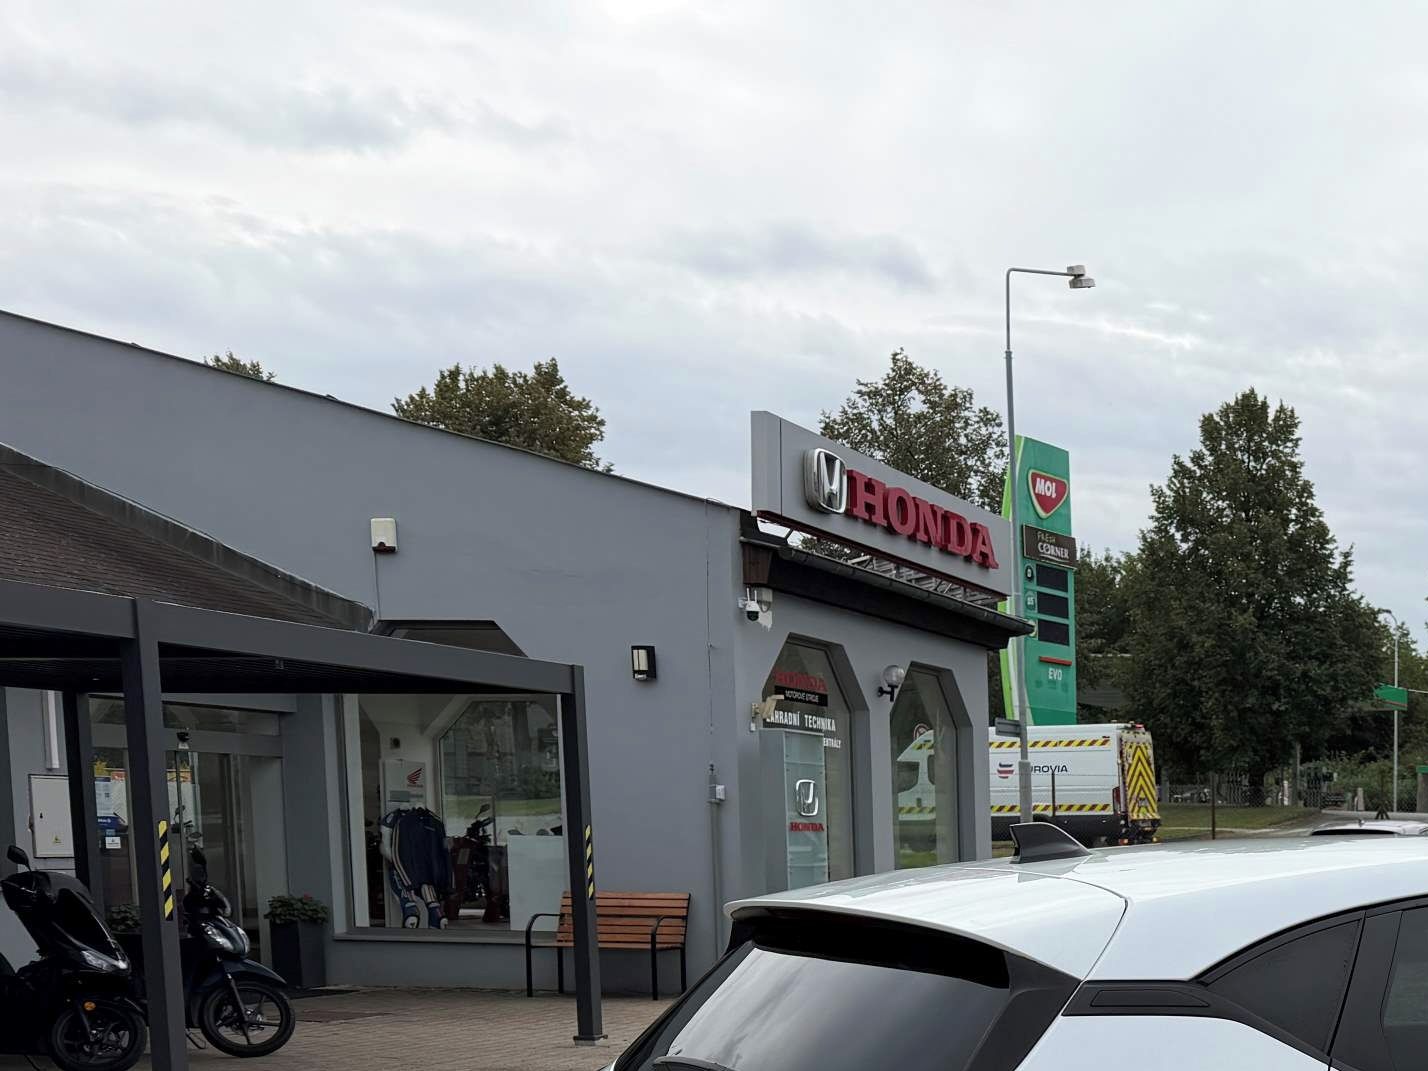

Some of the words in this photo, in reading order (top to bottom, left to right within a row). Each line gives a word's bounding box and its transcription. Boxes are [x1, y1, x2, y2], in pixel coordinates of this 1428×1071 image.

[1035, 477, 1057, 498] MOL
[846, 469, 1000, 570] HONDA
[1038, 542, 1070, 560] CORNER
[766, 711, 801, 727] AHRADNÍ
[804, 714, 836, 732] TECHNIKA
[1031, 764, 1068, 774] ROVIA
[789, 822, 825, 832] HONDA
